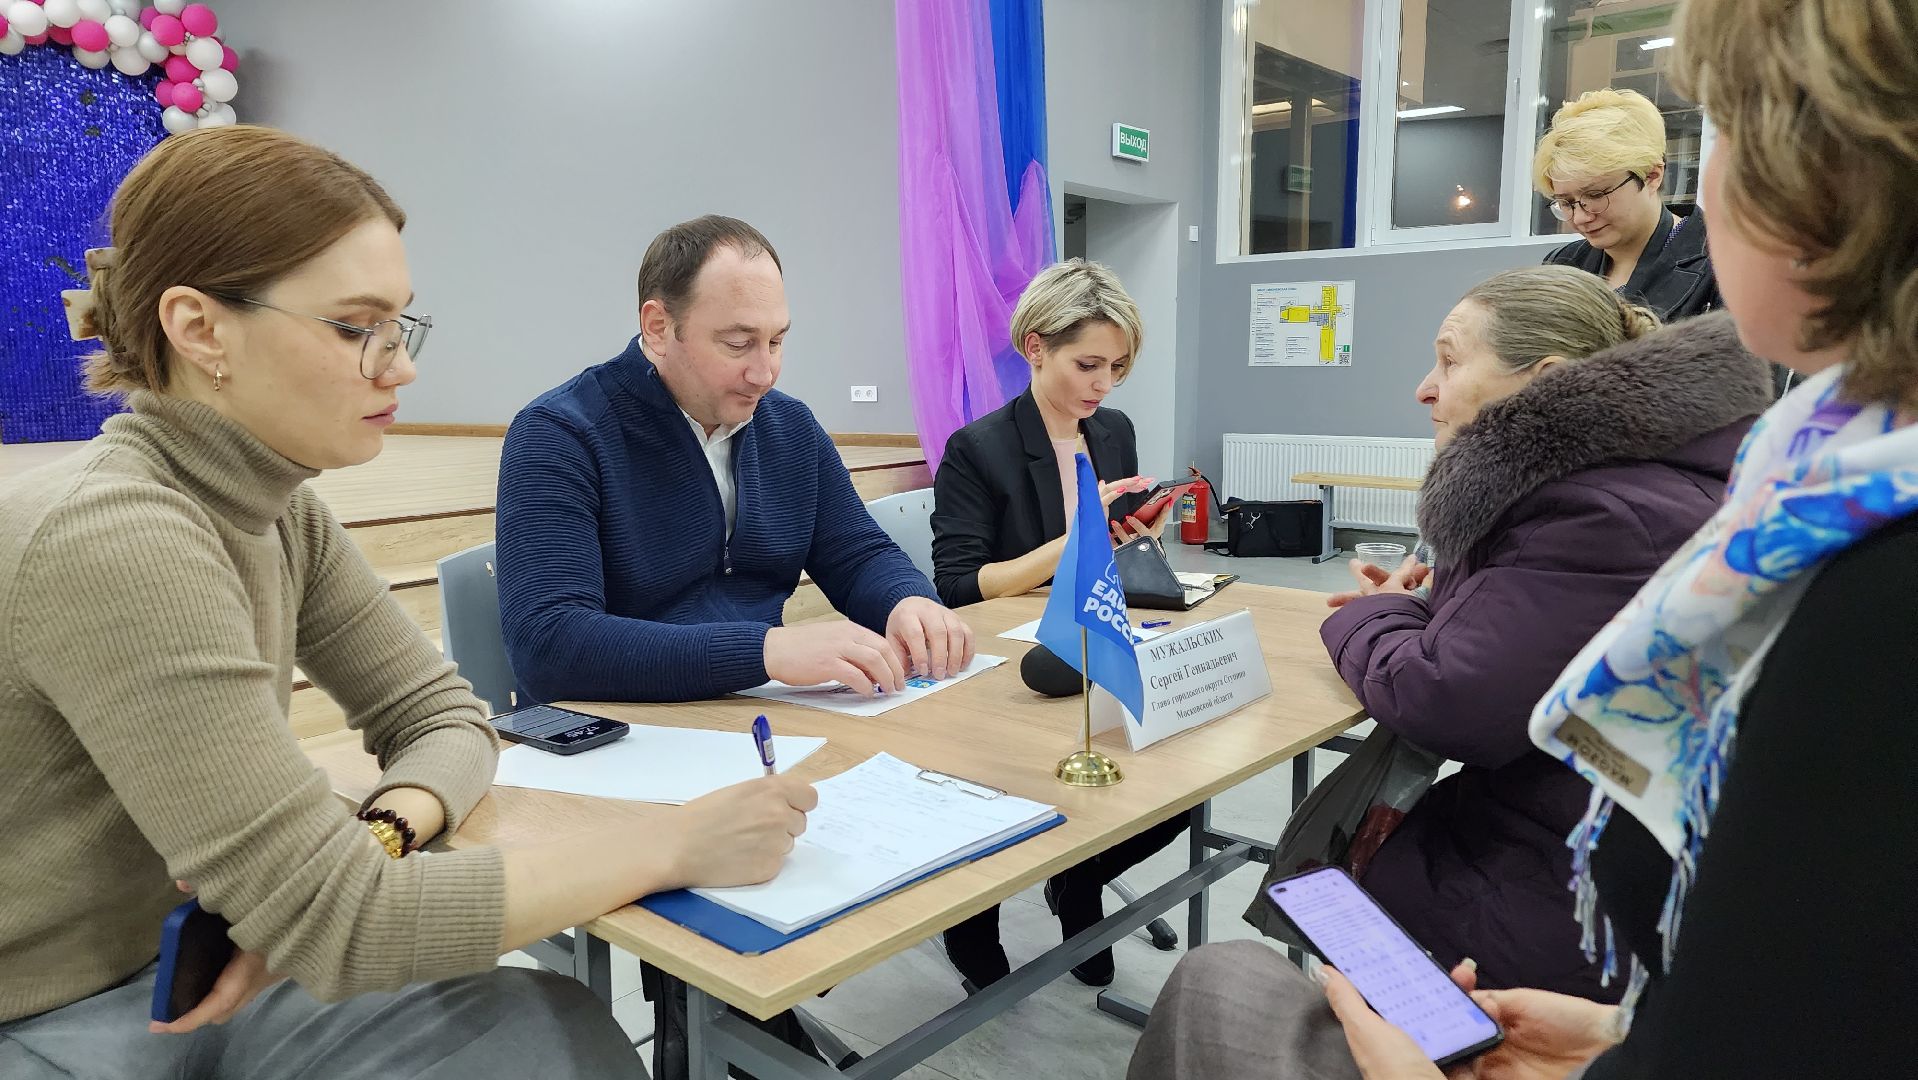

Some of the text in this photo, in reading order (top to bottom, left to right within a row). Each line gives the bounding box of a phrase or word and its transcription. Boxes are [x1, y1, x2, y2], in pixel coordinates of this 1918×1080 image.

[1120, 132, 1147, 153] ВЫХОД
[1150, 627, 1224, 662] МУЖАЛЬСКИХ
[1150, 651, 1239, 690] Сергей Геннадьевич
[1151, 670, 1246, 712] Глава городского округа Ступино
[1176, 691, 1234, 720] Московской области
